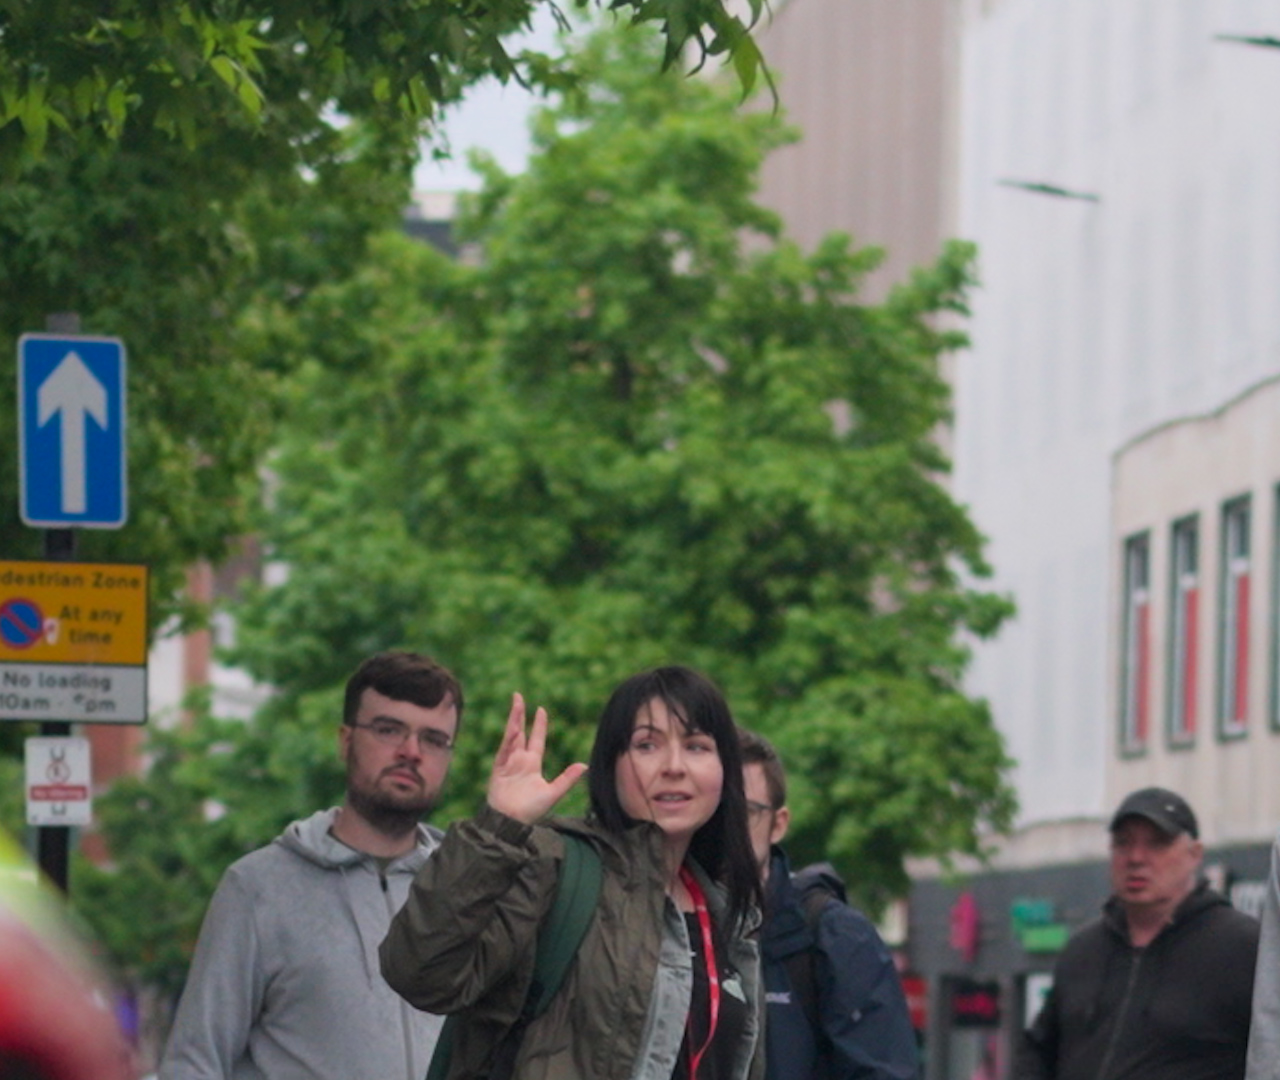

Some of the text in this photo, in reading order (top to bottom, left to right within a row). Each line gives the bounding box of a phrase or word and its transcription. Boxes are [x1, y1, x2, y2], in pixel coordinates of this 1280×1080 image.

[92, 572, 140, 588] Zone
[60, 605, 124, 624] At any
[69, 629, 112, 644] time
[2, 672, 112, 692] No loading
